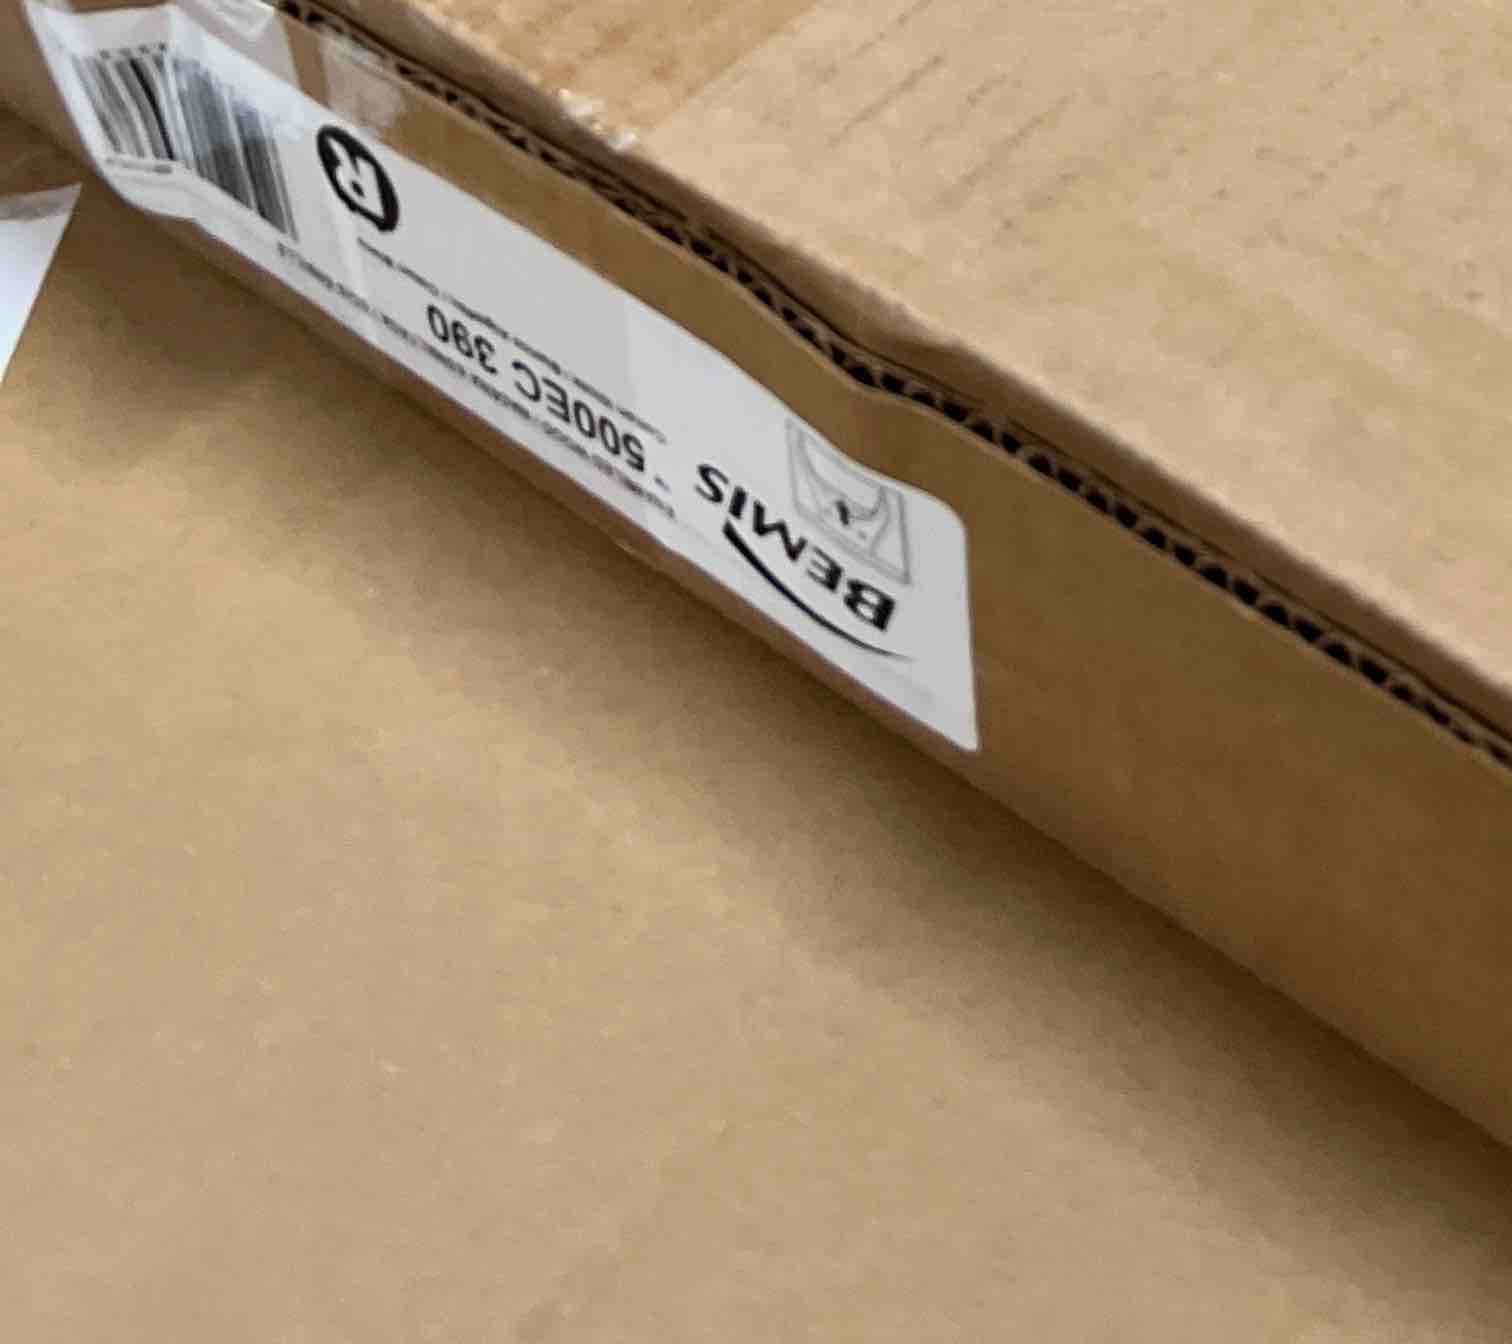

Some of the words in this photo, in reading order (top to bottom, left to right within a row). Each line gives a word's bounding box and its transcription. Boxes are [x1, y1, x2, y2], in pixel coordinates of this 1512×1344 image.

[426, 304, 498, 374] 390
[511, 359, 647, 473] 500EC
[695, 464, 896, 632] BEMIS
